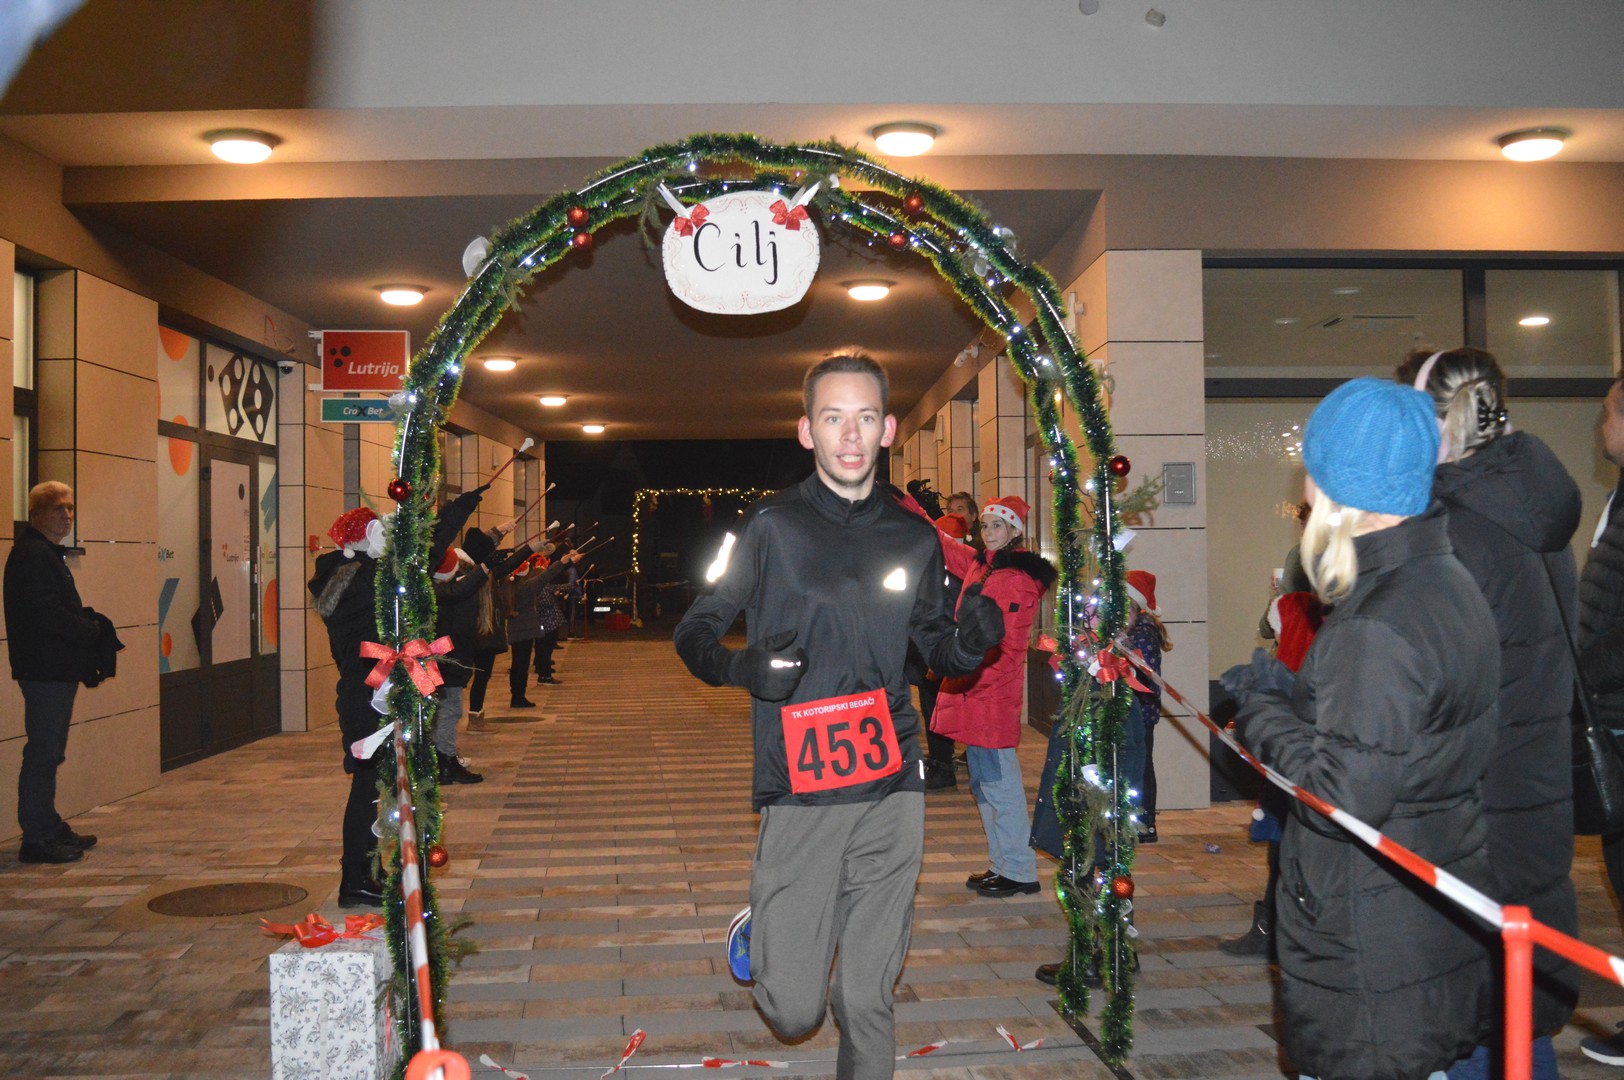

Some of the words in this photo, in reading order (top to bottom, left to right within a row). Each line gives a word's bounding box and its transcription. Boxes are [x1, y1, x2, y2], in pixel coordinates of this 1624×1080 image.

[693, 220, 778, 285] Cilj
[348, 361, 399, 377] Lutrija
[792, 710, 802, 719] TK
[803, 702, 848, 717] KOTORIPSKI
[849, 697, 875, 709] BEGAČI
[797, 717, 889, 780] 453
